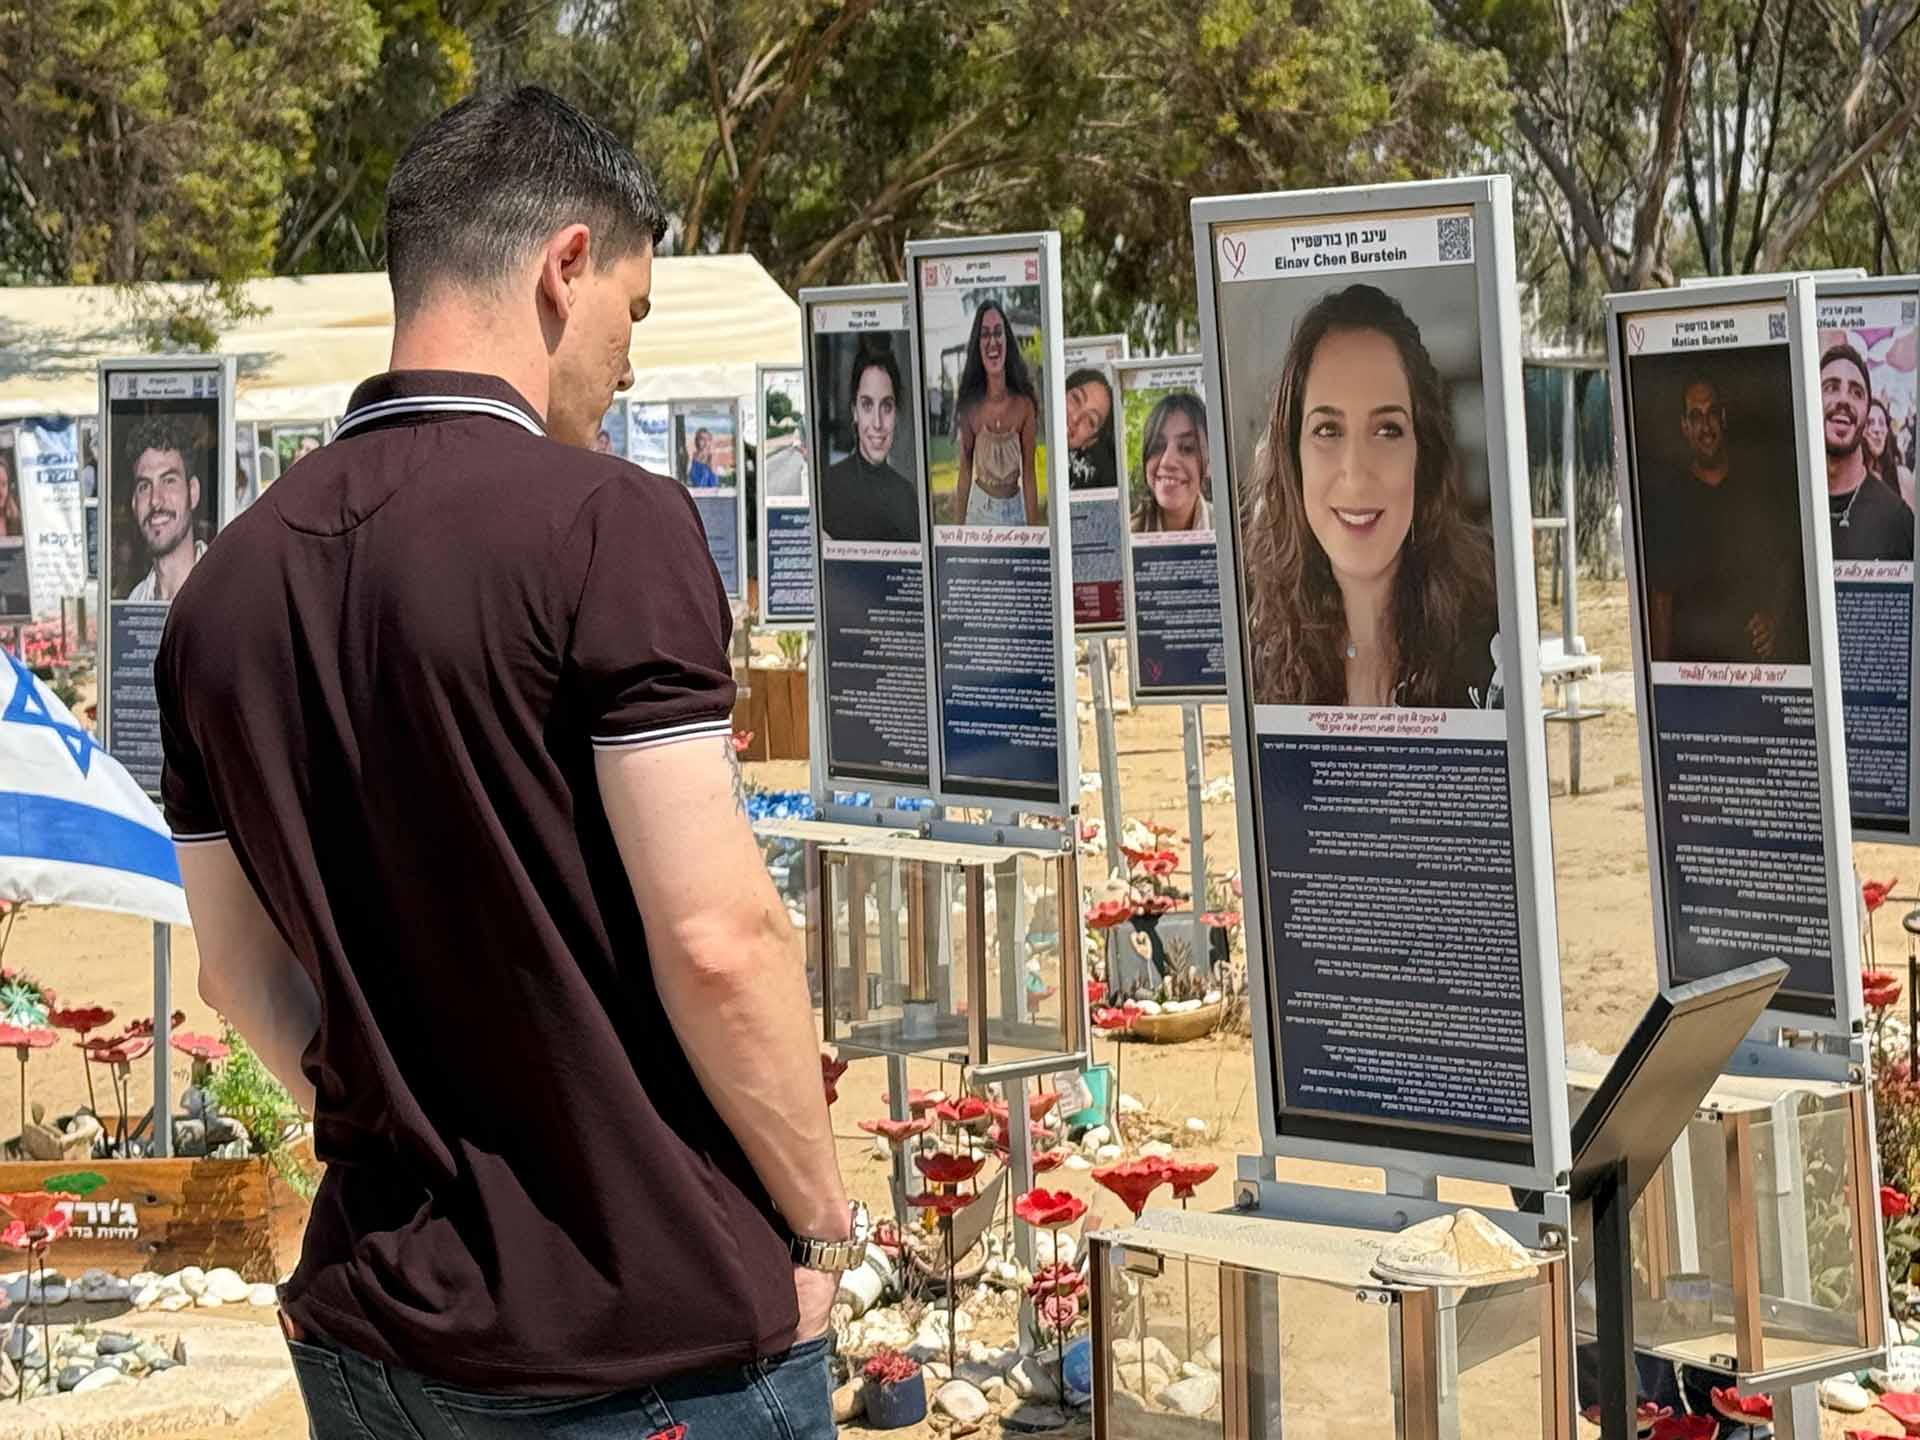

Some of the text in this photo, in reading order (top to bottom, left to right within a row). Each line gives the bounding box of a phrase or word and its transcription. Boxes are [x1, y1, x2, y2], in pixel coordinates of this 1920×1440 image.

[1291, 229, 1387, 253] עינב חן בורשטיין
[1275, 247, 1408, 270] Einav Chen Burstein
[1672, 334, 1738, 347] Matias Burstein
